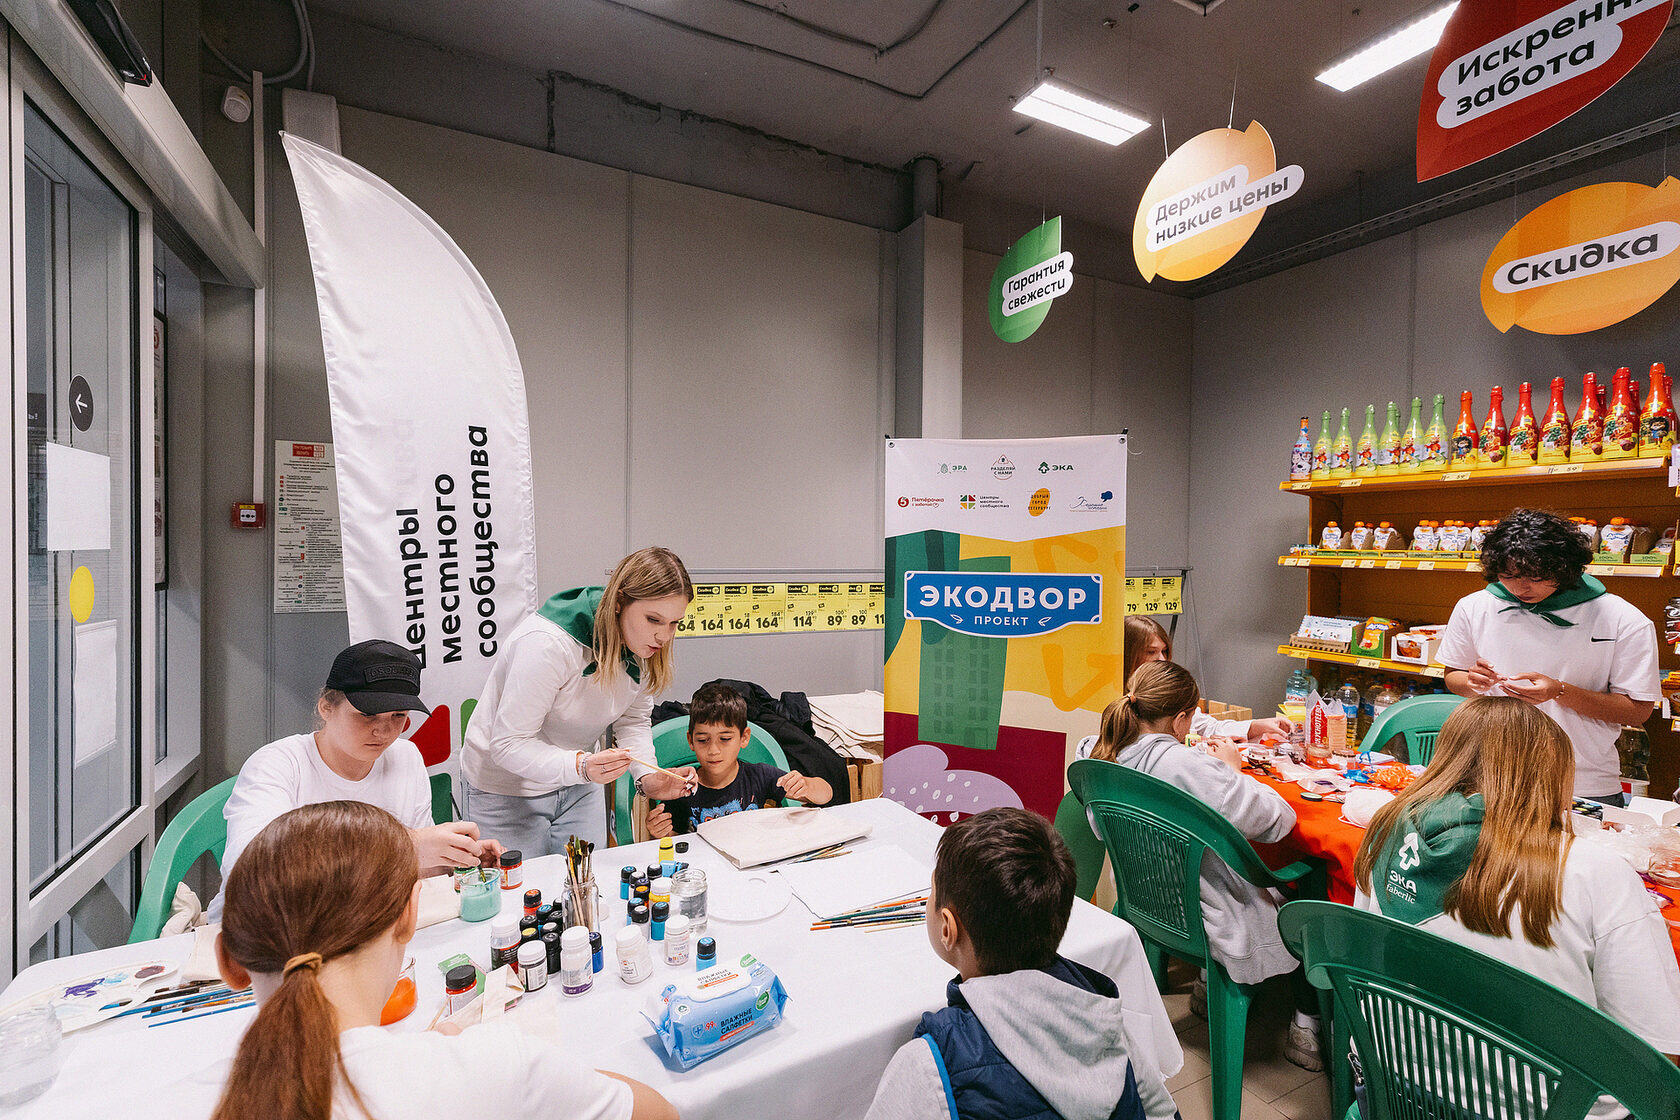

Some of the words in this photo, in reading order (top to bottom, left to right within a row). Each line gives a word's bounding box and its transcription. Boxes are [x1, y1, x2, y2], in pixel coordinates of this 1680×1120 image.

[1457, 0, 1645, 86] Искренн
[1456, 40, 1595, 116] забота
[1155, 174, 1237, 225] Держим
[1156, 207, 1223, 244] низкие
[1229, 176, 1289, 214] цены
[1507, 233, 1659, 286] Скидка
[1008, 258, 1065, 294] Гарантия
[1008, 277, 1066, 311] свежести
[468, 425, 499, 658] сообщества
[434, 473, 463, 664] местного
[919, 585, 1087, 613] ЭКОДВОР
[1127, 603, 1137, 612] 79
[1145, 602, 1158, 611] 129
[1165, 602, 1177, 610] 129
[701, 619, 723, 631] 164
[729, 618, 750, 630] 164
[756, 617, 778, 628] 164
[793, 616, 812, 627] 114
[827, 615, 842, 626] 89
[851, 615, 866, 625] 89
[974, 615, 1029, 626] ПРОЕКТ
[1389, 870, 1417, 893] ЭКА
[1386, 884, 1416, 904] faberlic
[720, 1008, 752, 1028] ВЛАЖНЫЕ
[720, 1014, 753, 1035] САЛФЕТКИ
